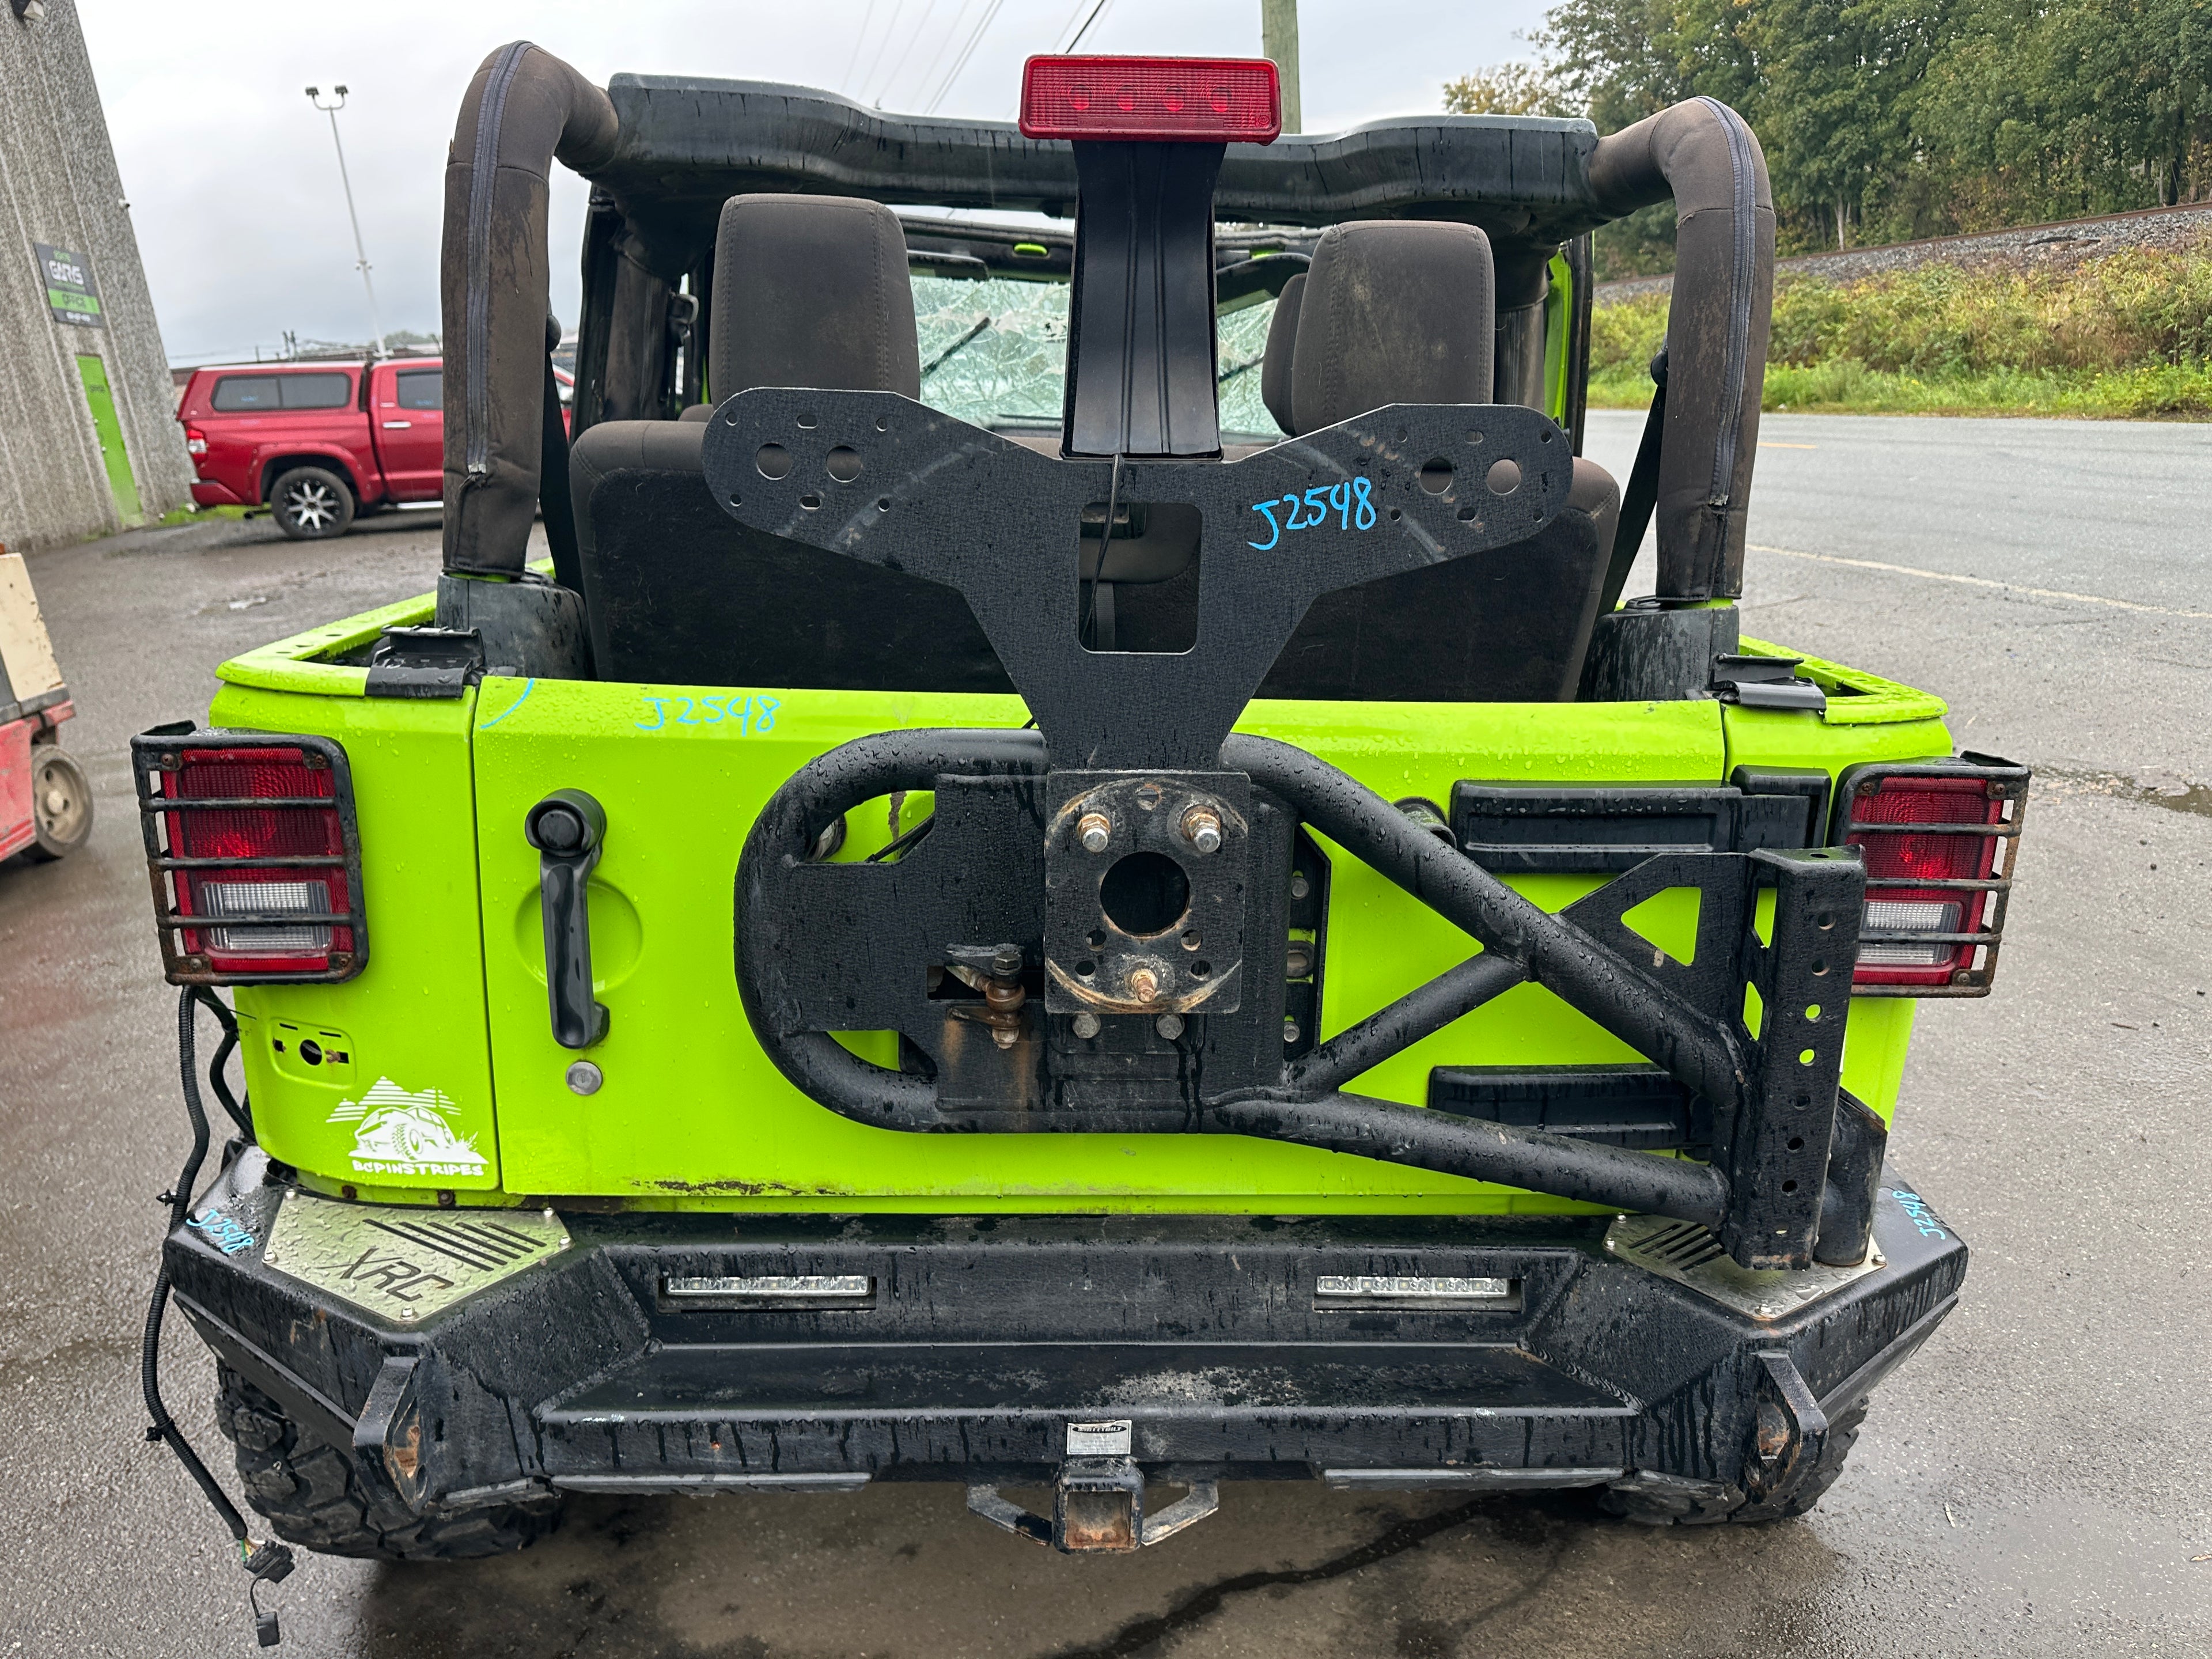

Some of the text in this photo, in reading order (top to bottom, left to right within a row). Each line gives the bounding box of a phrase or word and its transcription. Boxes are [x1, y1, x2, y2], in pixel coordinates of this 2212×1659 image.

[1247, 476, 1377, 551] J2548
[634, 695, 781, 737] J2548
[351, 1159, 484, 1176] BCPINSTRIPES
[185, 1209, 255, 1253] J2548
[1891, 1190, 1946, 1240] J2548
[313, 1247, 454, 1302] XRC
